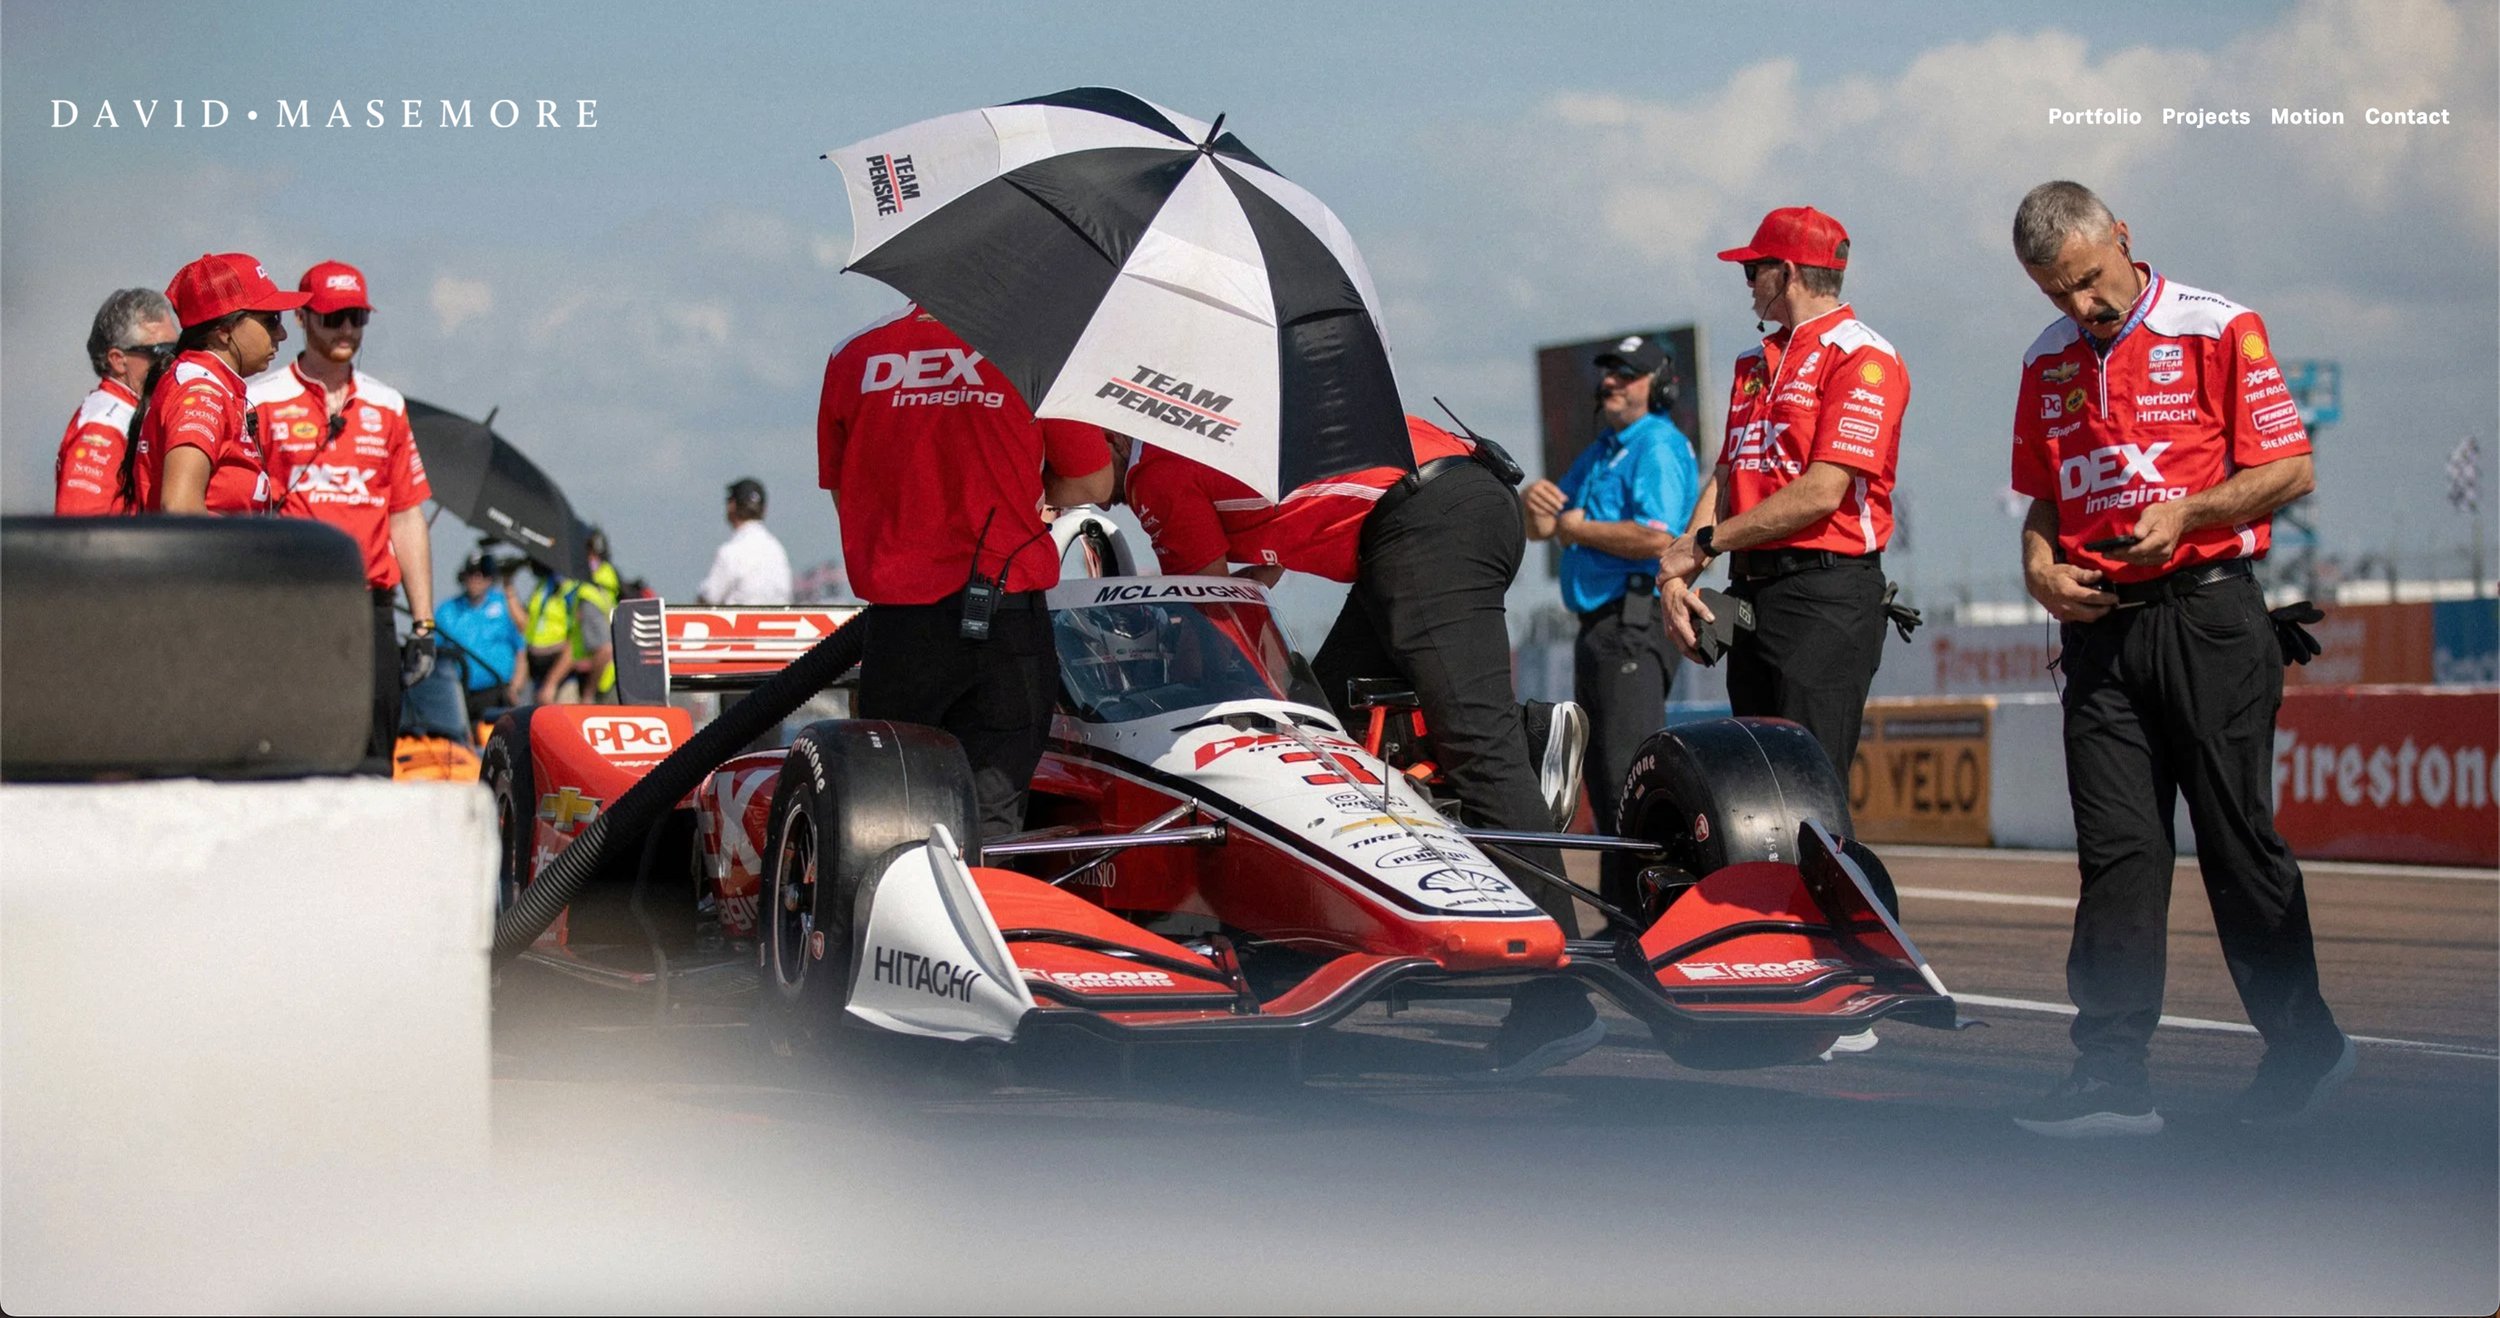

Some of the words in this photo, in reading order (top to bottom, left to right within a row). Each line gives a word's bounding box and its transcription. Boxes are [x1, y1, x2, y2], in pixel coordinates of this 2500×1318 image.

[866, 155, 898, 217] PENSKE
[894, 154, 921, 201] TEAM
[861, 348, 985, 395] DEX
[1131, 364, 1234, 413] TEAM
[892, 386, 1004, 409] imaging
[1095, 381, 1237, 443] PENSKE
[2136, 391, 2190, 406] verizon
[2136, 409, 2196, 423] HITACHI
[1832, 440, 1875, 458] SIEMENS
[288, 463, 377, 497] DEX
[2059, 441, 2173, 501] DEX
[2085, 484, 2188, 514] imaging
[587, 721, 668, 751] PPG
[1278, 752, 1384, 785] 3
[1887, 750, 1979, 812] VELO
[875, 946, 982, 1003] HITACHI
[1051, 971, 1169, 981] GOOD
